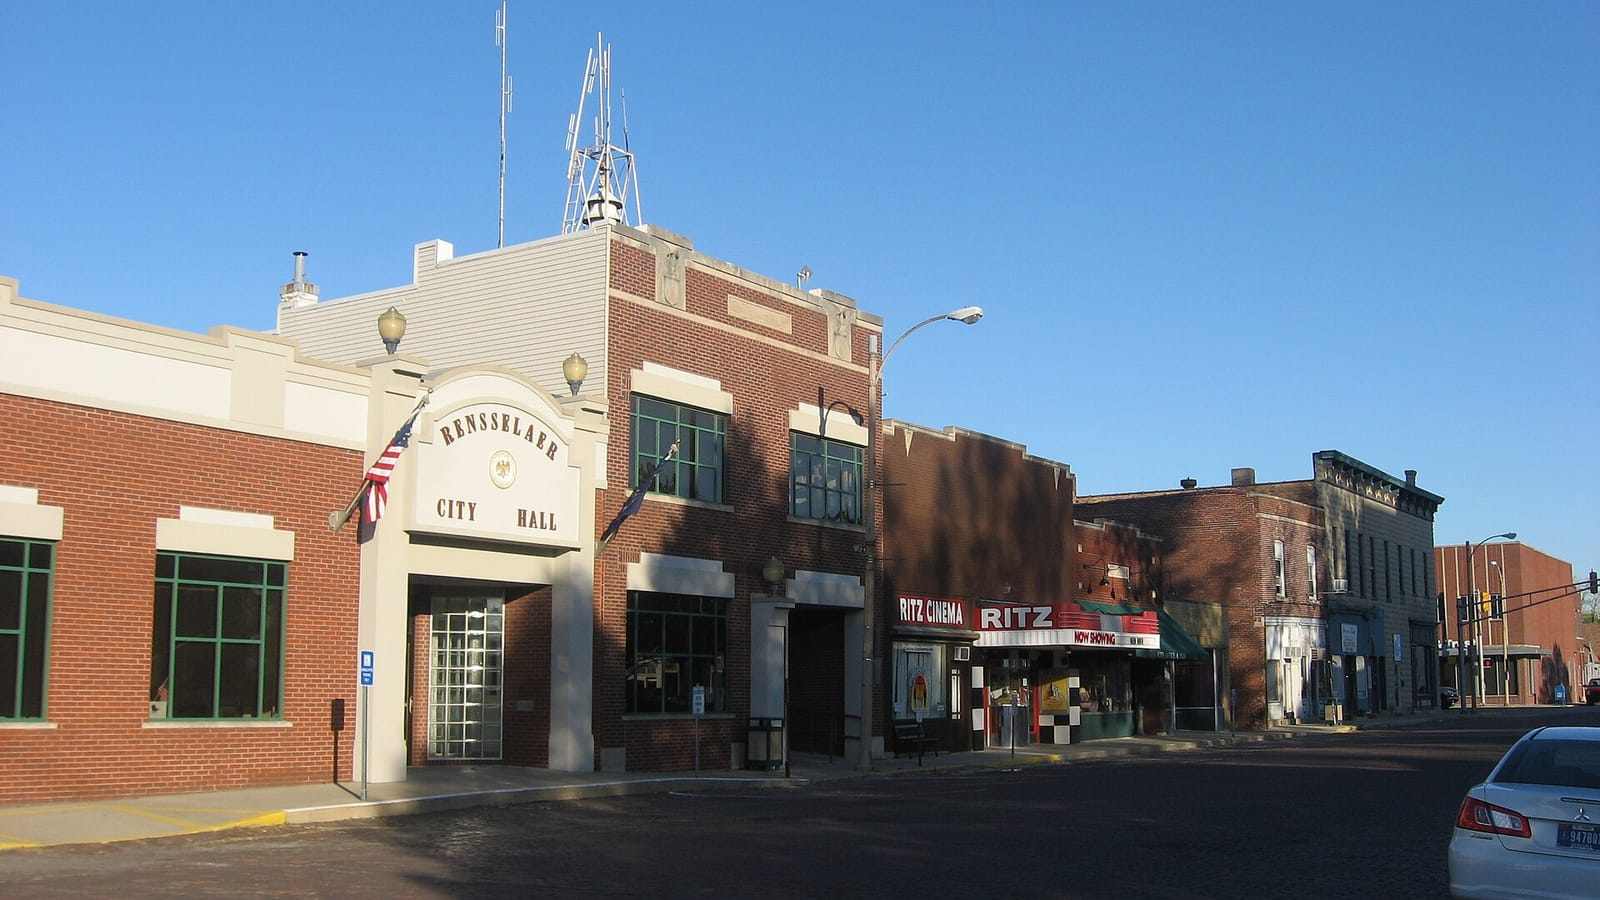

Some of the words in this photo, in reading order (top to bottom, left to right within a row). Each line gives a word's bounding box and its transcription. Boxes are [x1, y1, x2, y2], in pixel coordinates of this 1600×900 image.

[440, 412, 560, 461] RENSSELAER
[437, 498, 477, 522] CITY
[517, 508, 557, 531] HALL
[899, 597, 924, 622] RITZ
[926, 599, 963, 625] CINEMA
[981, 606, 1053, 629] RITZ
[1074, 630, 1089, 644] NOW
[1090, 631, 1116, 645] SHOWING
